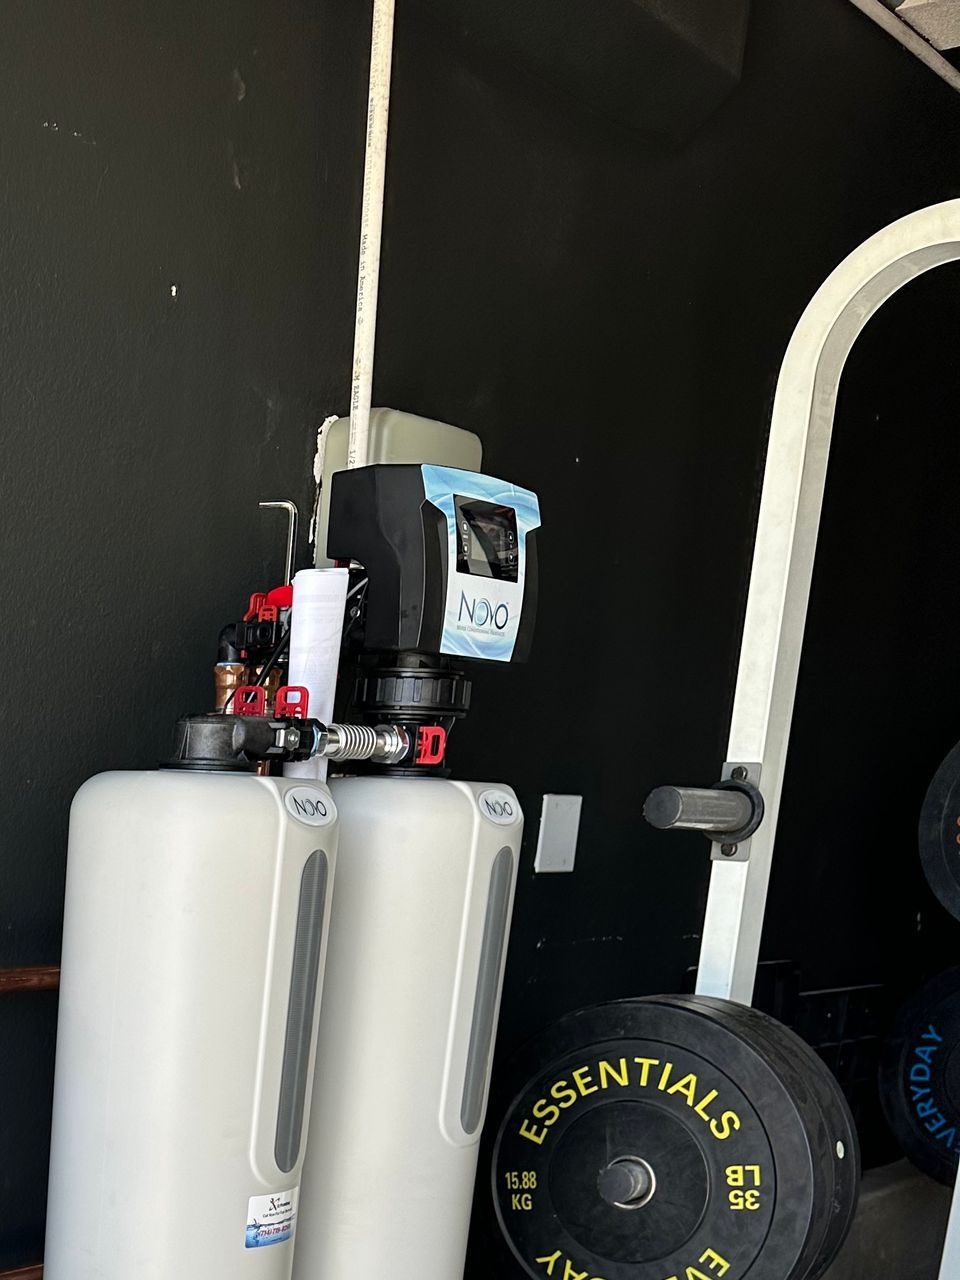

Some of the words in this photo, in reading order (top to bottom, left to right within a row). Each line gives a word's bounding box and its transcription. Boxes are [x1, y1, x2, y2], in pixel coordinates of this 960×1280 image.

[457, 589, 509, 630] NOVO
[292, 795, 327, 818] NOVO
[485, 797, 513, 818] NOVO
[909, 1023, 960, 1152] VERYDAY
[519, 1056, 741, 1146] ESSENTIALS
[504, 1171, 537, 1190] 15.88
[725, 1164, 762, 1186] LB
[511, 1193, 533, 1211] KG
[729, 1189, 761, 1211] 35
